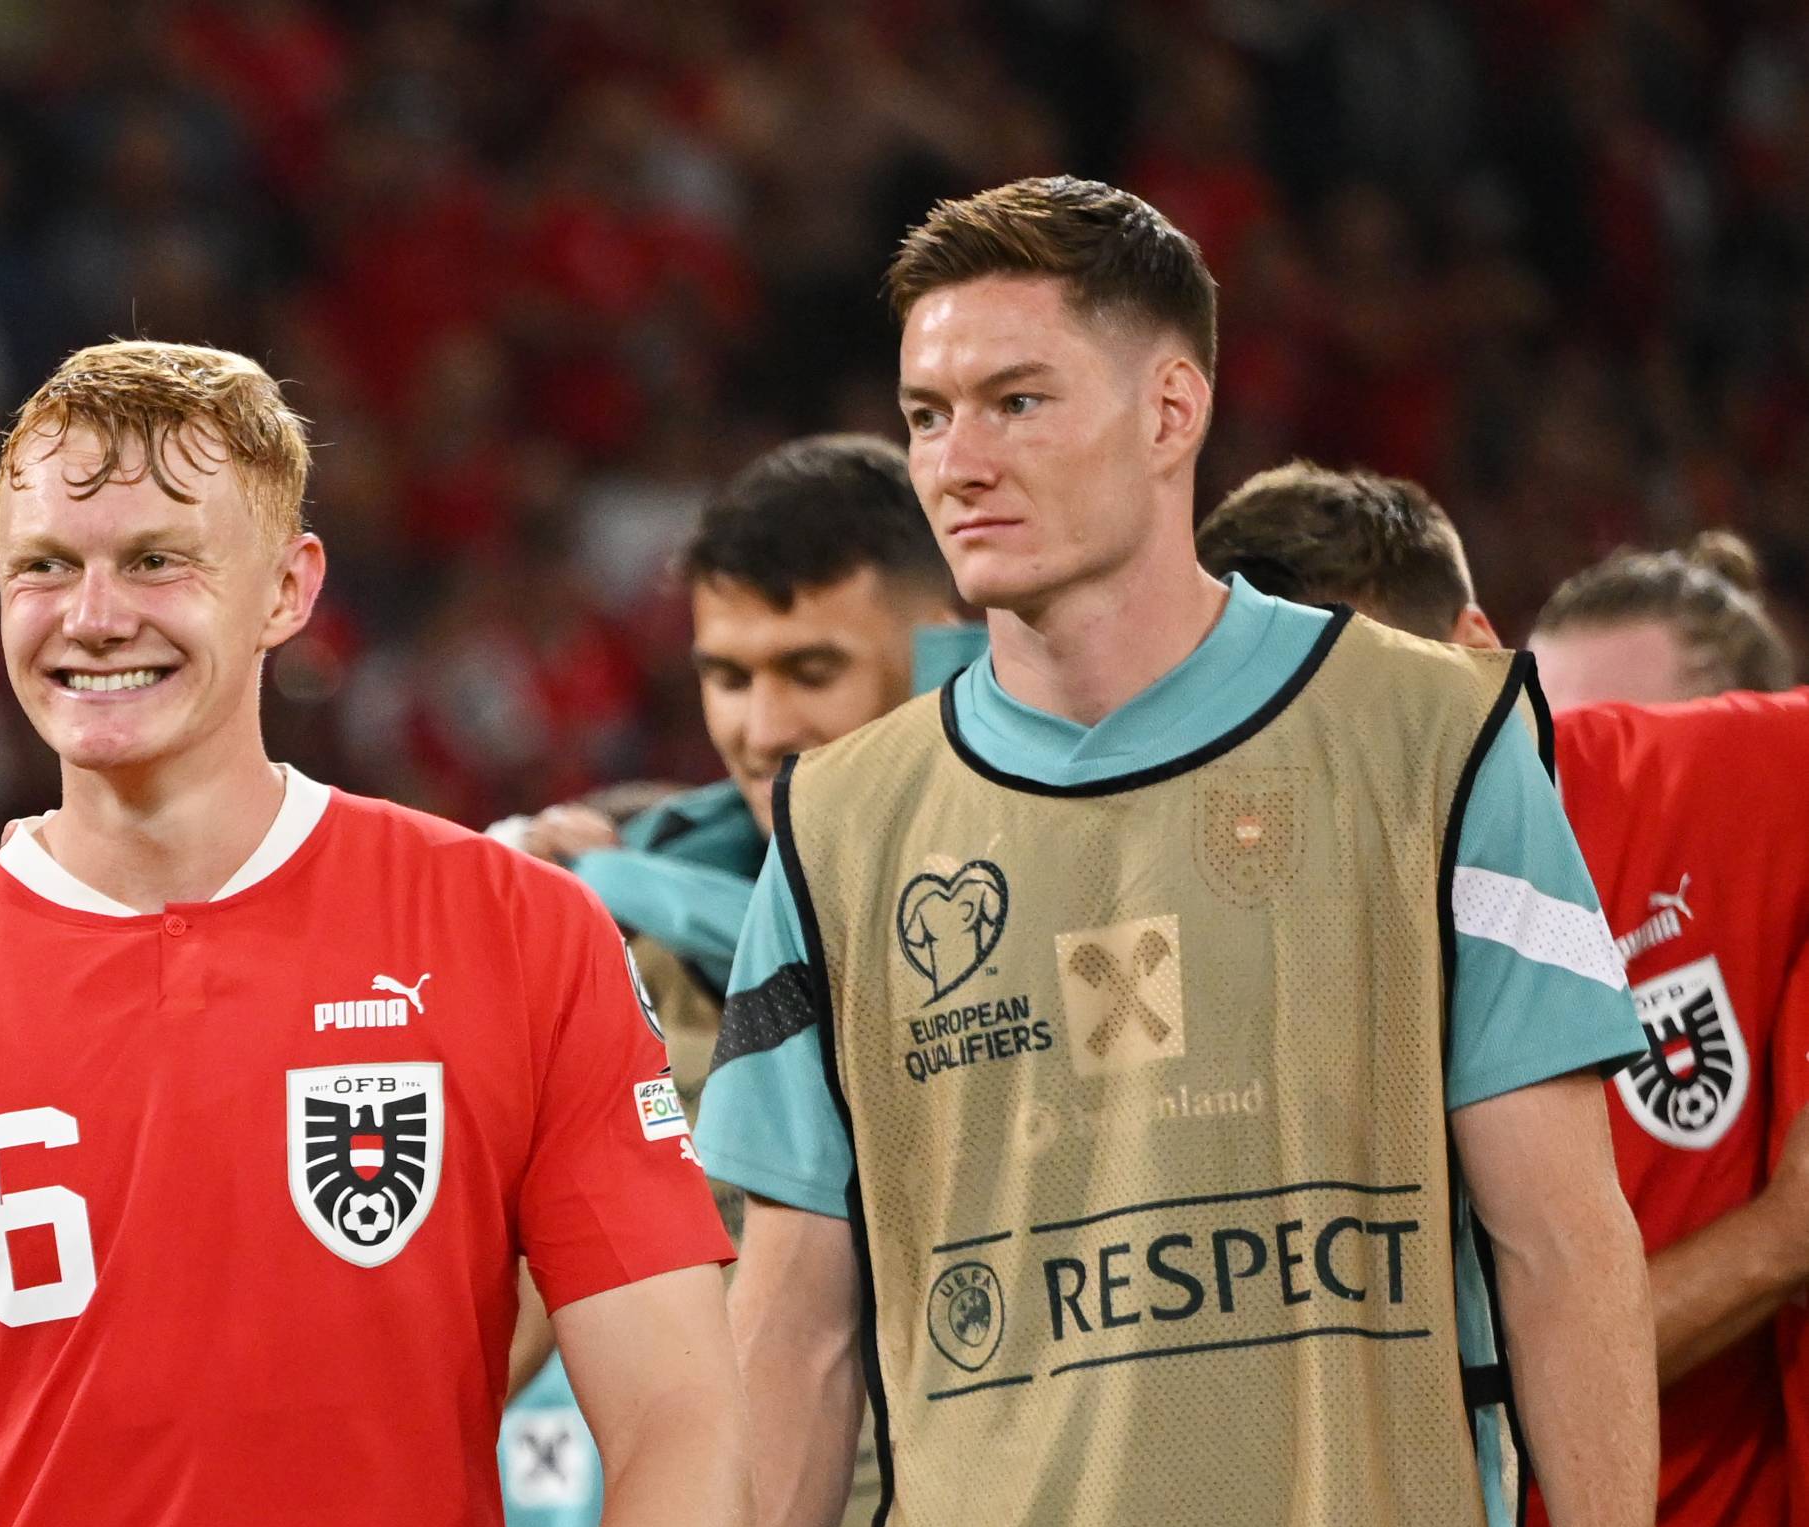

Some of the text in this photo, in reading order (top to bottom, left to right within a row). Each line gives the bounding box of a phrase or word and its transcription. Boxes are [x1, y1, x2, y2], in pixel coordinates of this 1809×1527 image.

[314, 998, 409, 1032] PUMA
[910, 995, 1030, 1045] EUROPEAN
[905, 1021, 1053, 1083] QUALIFIERS
[334, 1075, 397, 1094] ÖFB
[640, 1083, 665, 1098] UEFA
[1043, 1216, 1419, 1341] RESPECT
